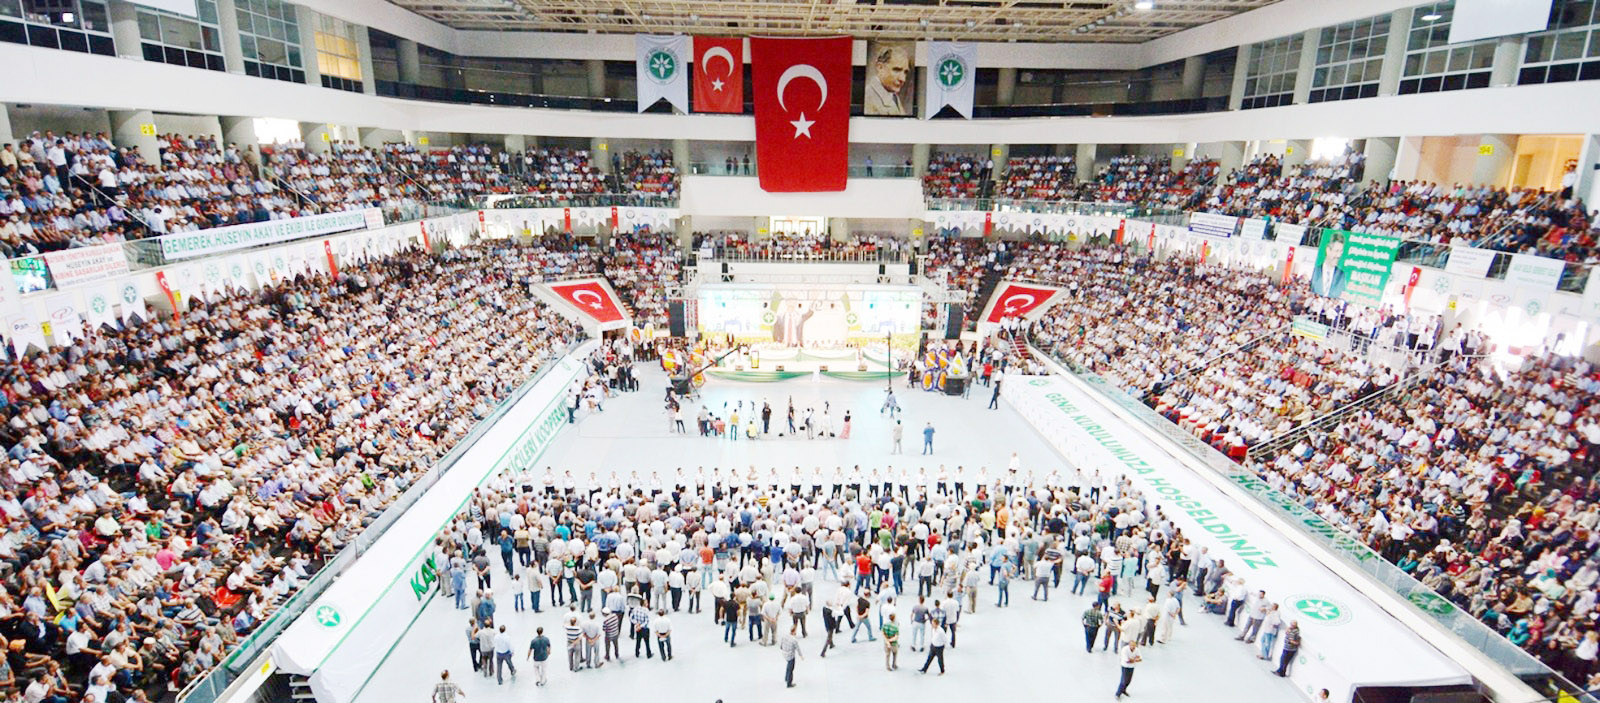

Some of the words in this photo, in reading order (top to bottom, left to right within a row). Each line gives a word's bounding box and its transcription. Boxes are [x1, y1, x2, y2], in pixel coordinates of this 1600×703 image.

[1044, 392, 1080, 414] GENEL
[1070, 414, 1155, 475] KURULUMUZA
[1143, 477, 1279, 570] HOŞGELDİNİZ
[410, 552, 437, 601] KAY
